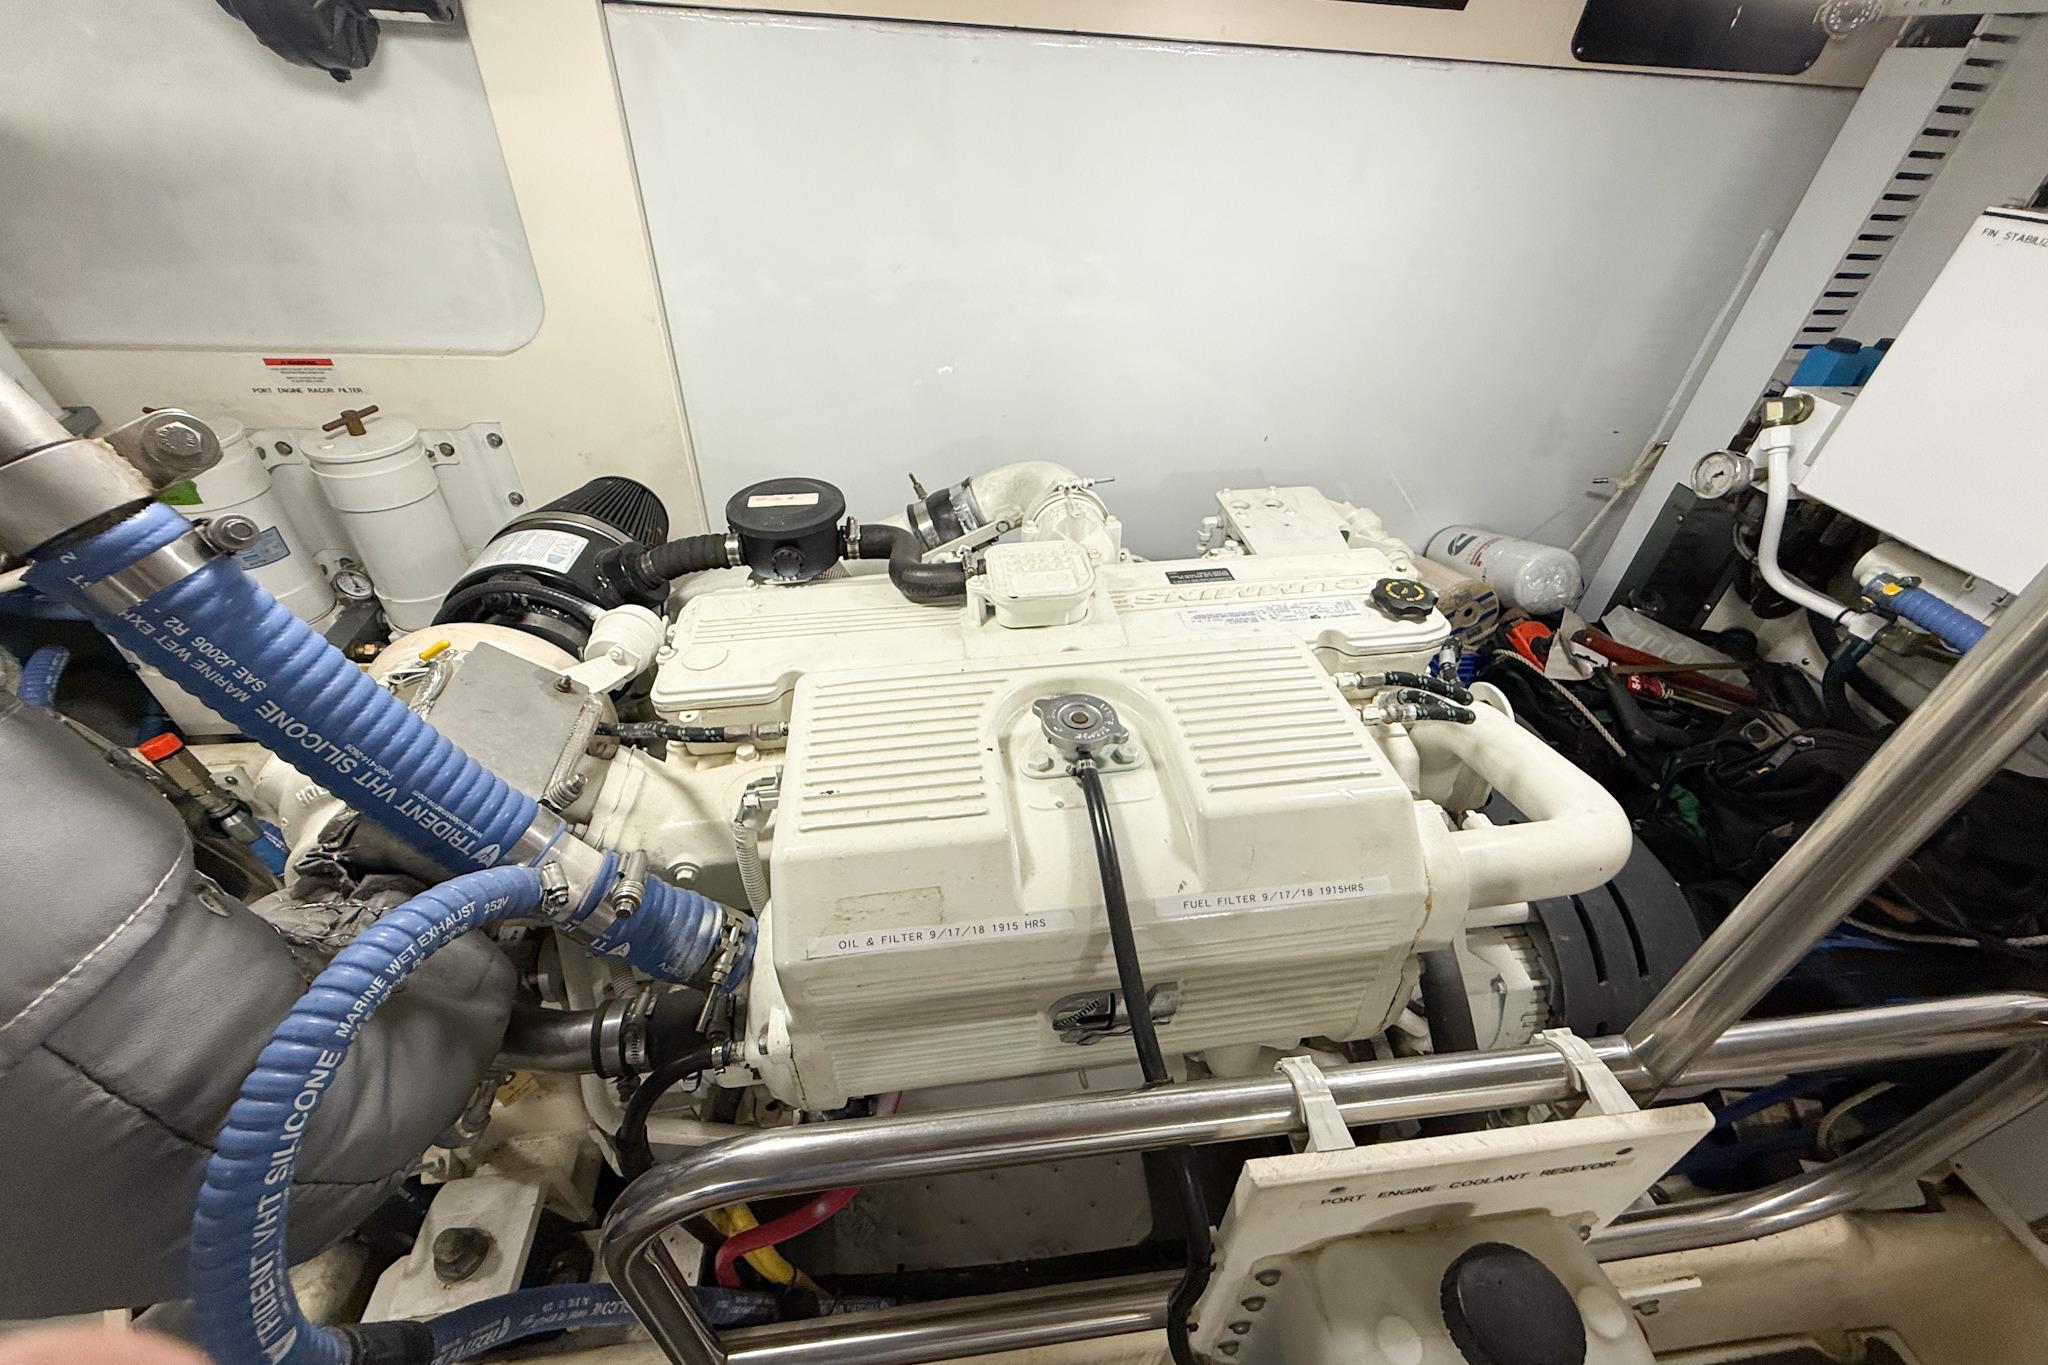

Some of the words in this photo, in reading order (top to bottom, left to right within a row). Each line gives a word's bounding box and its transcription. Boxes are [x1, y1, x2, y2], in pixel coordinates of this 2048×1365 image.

[1982, 228, 2000, 238] FIN
[161, 615, 191, 637] R2
[153, 632, 196, 663] WET
[190, 636, 238, 668] J2006
[190, 659, 251, 704] MARINE
[232, 665, 268, 693] SAE
[255, 699, 358, 775] SILICONE
[352, 774, 399, 804] VHT
[394, 797, 484, 857] TRIDENT
[483, 895, 510, 915] 252V
[1183, 898, 1212, 910] FUEL
[1217, 894, 1257, 907] FILTER
[1261, 887, 1314, 902] 9/17/18
[1319, 882, 1365, 896] 1915HRS
[416, 900, 477, 949] EXHAUST
[838, 938, 860, 950] OIL
[866, 936, 875, 947] &
[881, 930, 924, 945] FILTER
[929, 924, 986, 941] 9/17/18
[992, 920, 1020, 933] 1915
[1024, 918, 1047, 930] HRS
[384, 943, 418, 976] WET
[335, 974, 388, 1039] MARINE
[263, 1049, 343, 1187] SILICONE
[1320, 1193, 1366, 1206] PORT
[1376, 1184, 1437, 1199] ENGINE
[1449, 1172, 1529, 1189] COOLANT
[1538, 1159, 1617, 1178] RESEVOIR
[253, 1189, 283, 1247] VHT
[249, 1248, 282, 1348] TRIDENT
